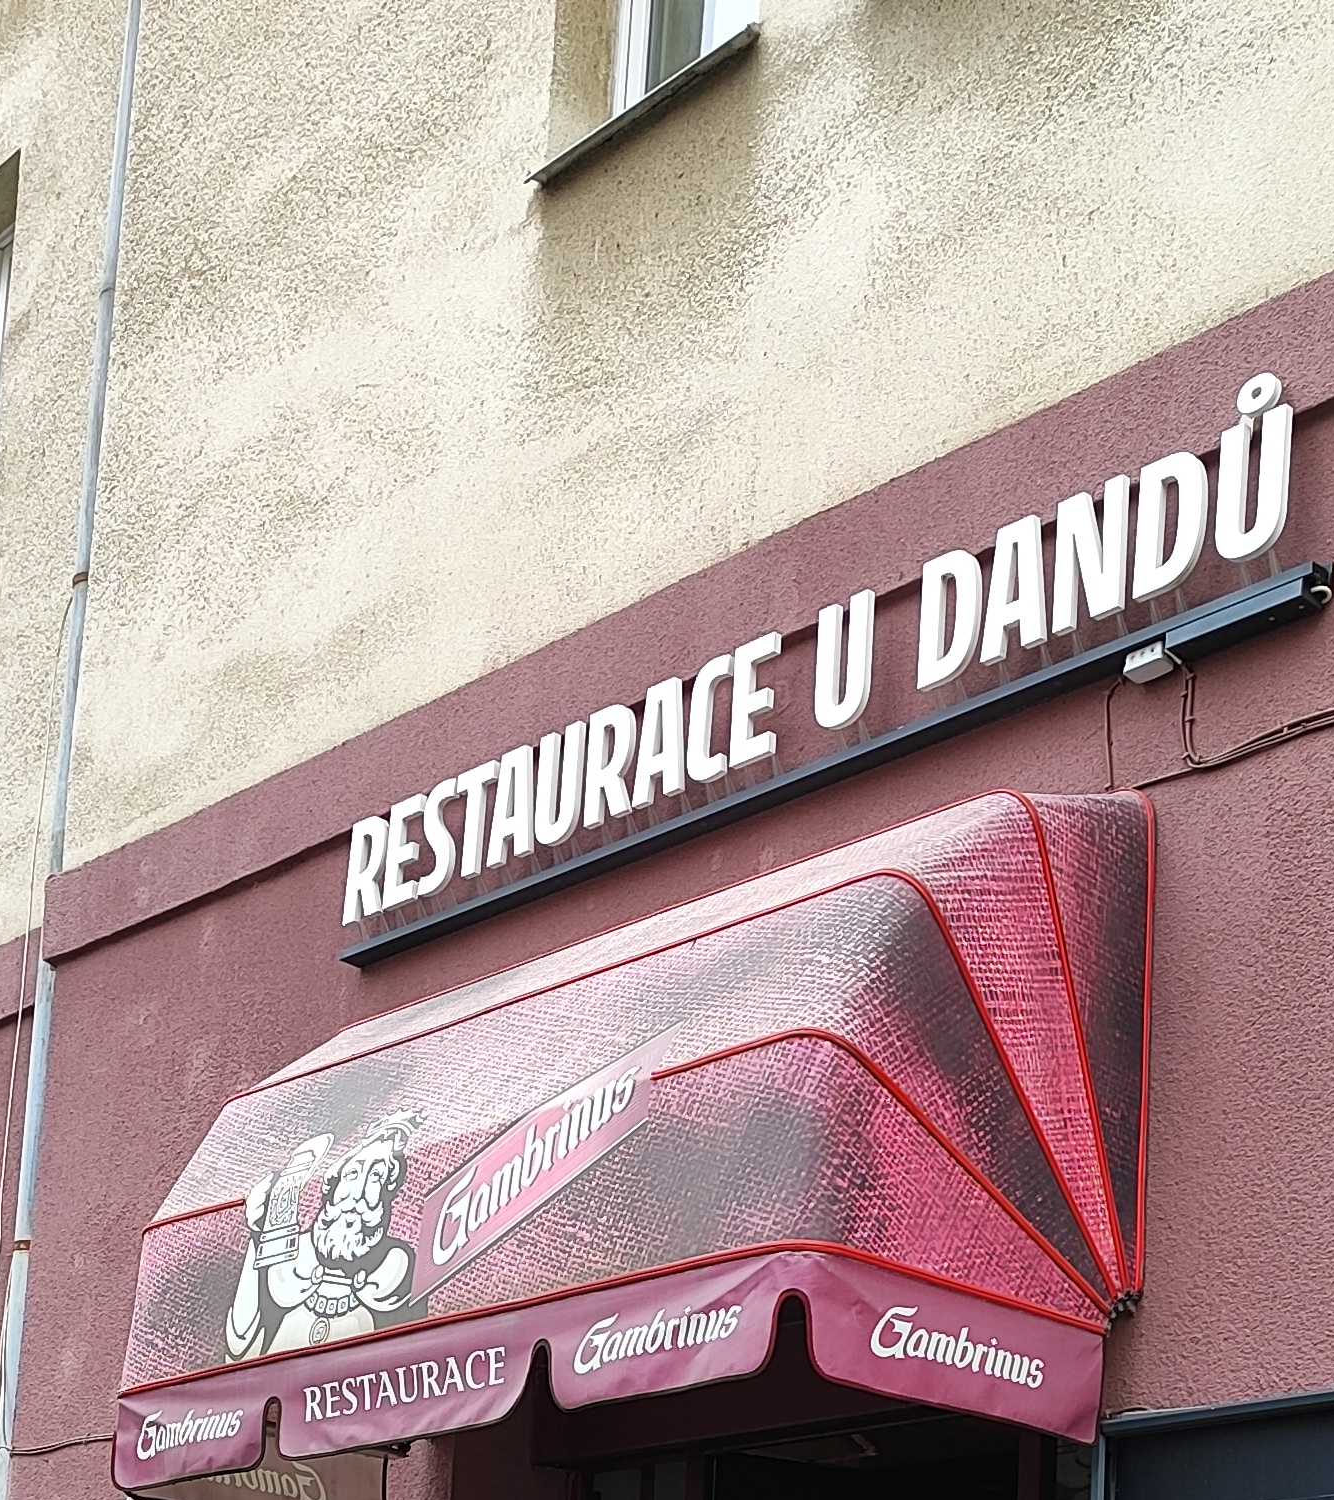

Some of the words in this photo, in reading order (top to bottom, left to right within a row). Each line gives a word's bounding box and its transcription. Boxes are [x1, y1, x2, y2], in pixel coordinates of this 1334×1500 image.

[342, 630, 784, 927] RESTAURACE
[813, 588, 876, 732] U
[915, 371, 1295, 692] DANDŮ
[431, 1064, 641, 1269] Gambrinus
[572, 1302, 744, 1376] Gambrinus
[869, 1305, 1046, 1389] Gambrinus
[303, 1345, 507, 1424] RESTAURACE
[136, 1407, 245, 1461] Gambrinus
